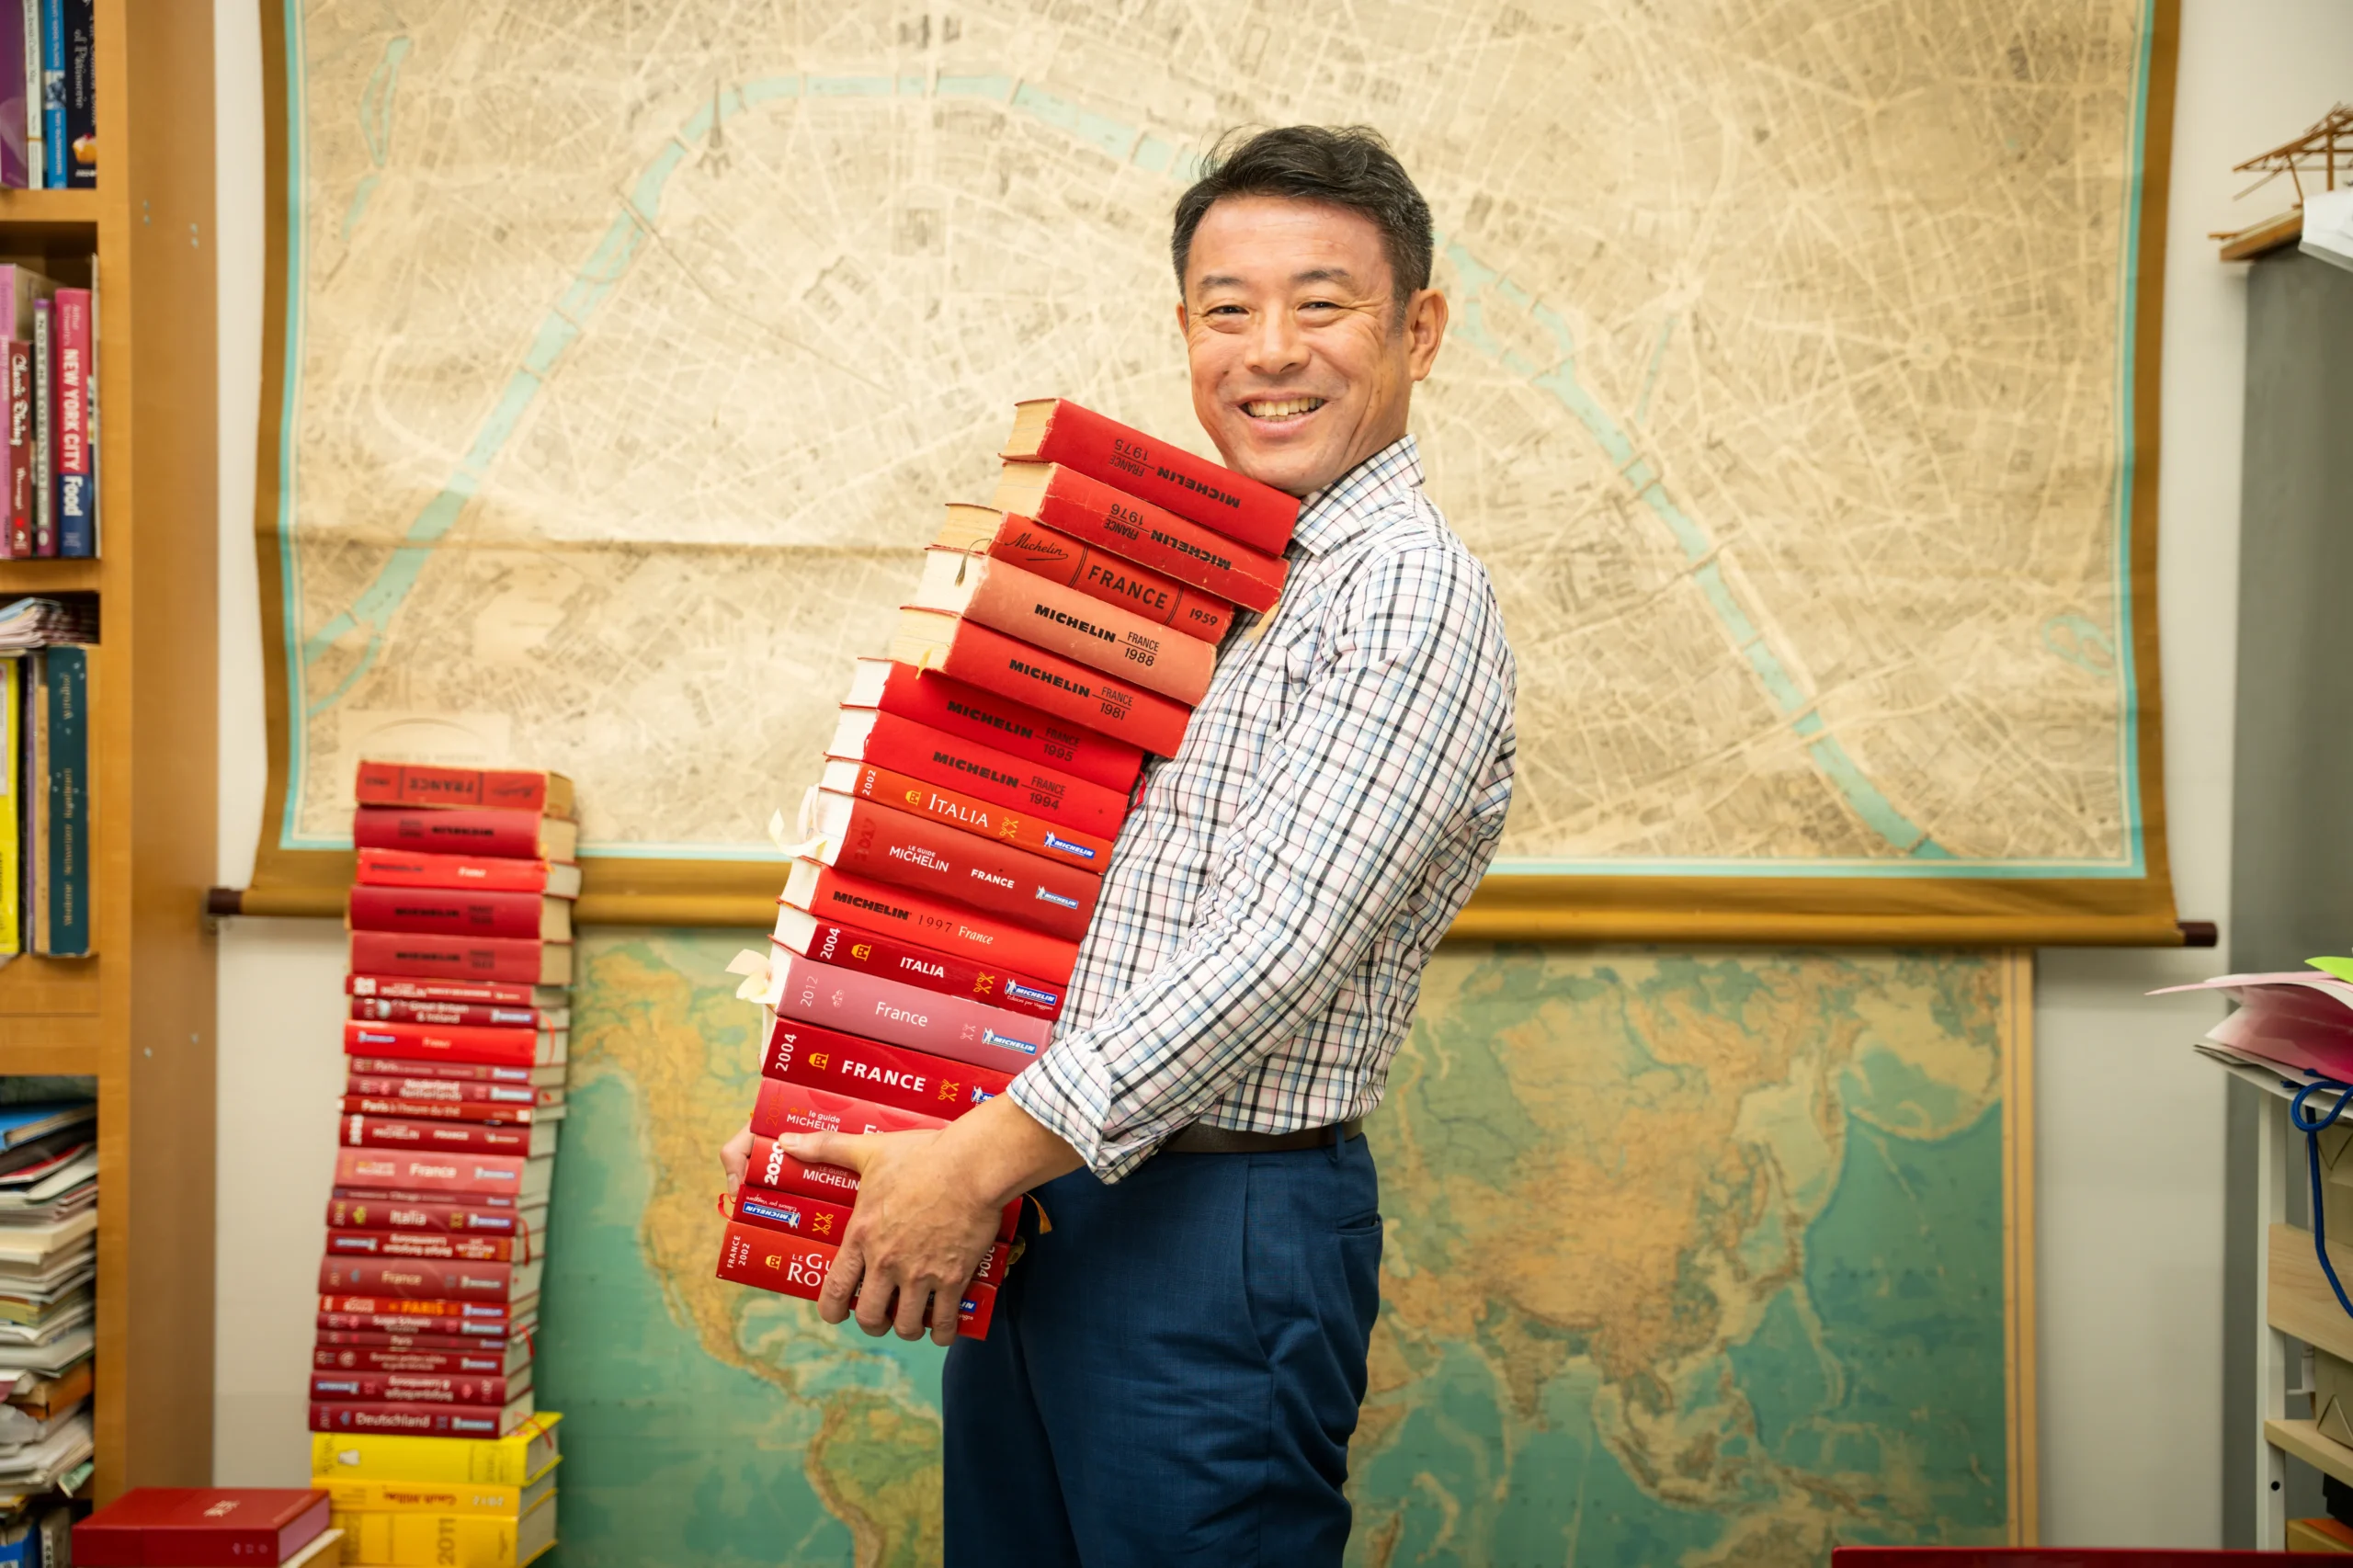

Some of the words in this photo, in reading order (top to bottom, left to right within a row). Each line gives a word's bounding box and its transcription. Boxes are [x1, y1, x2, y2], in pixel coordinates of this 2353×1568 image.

[12, 353, 28, 398] Classic
[63, 348, 80, 384] NEW
[63, 386, 80, 430] YORK
[10, 399, 28, 447] Dining
[63, 432, 80, 471] CITY
[1114, 438, 1149, 461] 1975
[1109, 454, 1143, 478] FRANCE
[63, 474, 83, 517] Food
[1156, 466, 1242, 508] MICHELIN
[1110, 503, 1143, 526] 1976
[1104, 517, 1139, 540] FRANCE
[1005, 532, 1069, 561] Michelin
[1150, 528, 1232, 571] MICHELIN
[1087, 564, 1168, 610] FRANCE
[1034, 603, 1116, 643] MICHELIN
[1188, 607, 1218, 627] 1959
[1127, 631, 1160, 652] FRANCE
[1124, 646, 1155, 667] 1988
[1008, 658, 1090, 699] MICHELIN
[1101, 686, 1133, 708] FRANCE
[947, 700, 1034, 739] MICHELIN
[1099, 701, 1126, 721] 1981
[1044, 727, 1080, 748] FRANCE
[1043, 743, 1074, 762] 1995
[932, 751, 1019, 790] MICHELIN
[409, 778, 473, 793] FRANCE
[861, 769, 878, 796] 2002
[1030, 776, 1067, 797] FRANCE
[928, 793, 989, 828] ITALIA
[1029, 792, 1060, 811] 1994
[889, 846, 949, 872] MICHELIN
[917, 846, 936, 858] GUIDE
[1055, 840, 1094, 857] MICHELIN
[971, 869, 1016, 889] FRANCE
[1044, 892, 1077, 906] MICHELIN
[833, 891, 910, 920] MICHELIN
[918, 915, 952, 933] 1997
[958, 926, 994, 946] France
[820, 927, 841, 960] 2004
[900, 956, 945, 979] ITALIA
[801, 975, 819, 1007] 2012
[1016, 988, 1055, 1002] MICHELIN
[875, 1000, 928, 1028] France
[775, 1033, 797, 1072] 2004
[994, 1036, 1036, 1051] MICHELIN
[841, 1060, 926, 1093] FRANCE
[787, 1114, 838, 1132] MICHELIN
[817, 1112, 840, 1123] guide
[409, 1163, 457, 1178] France
[764, 1141, 785, 1186] 2020
[828, 1168, 848, 1176] GUIDE
[802, 1169, 860, 1190] MICHELIN
[390, 1210, 426, 1225] Italia
[745, 1206, 789, 1220] MICHELIN
[727, 1235, 741, 1268] FRANCE
[738, 1243, 751, 1266] 2002
[381, 1270, 422, 1285] France
[401, 1301, 444, 1315] PARIS
[355, 1412, 430, 1428] Deutschland
[438, 1517, 457, 1566] 2011
